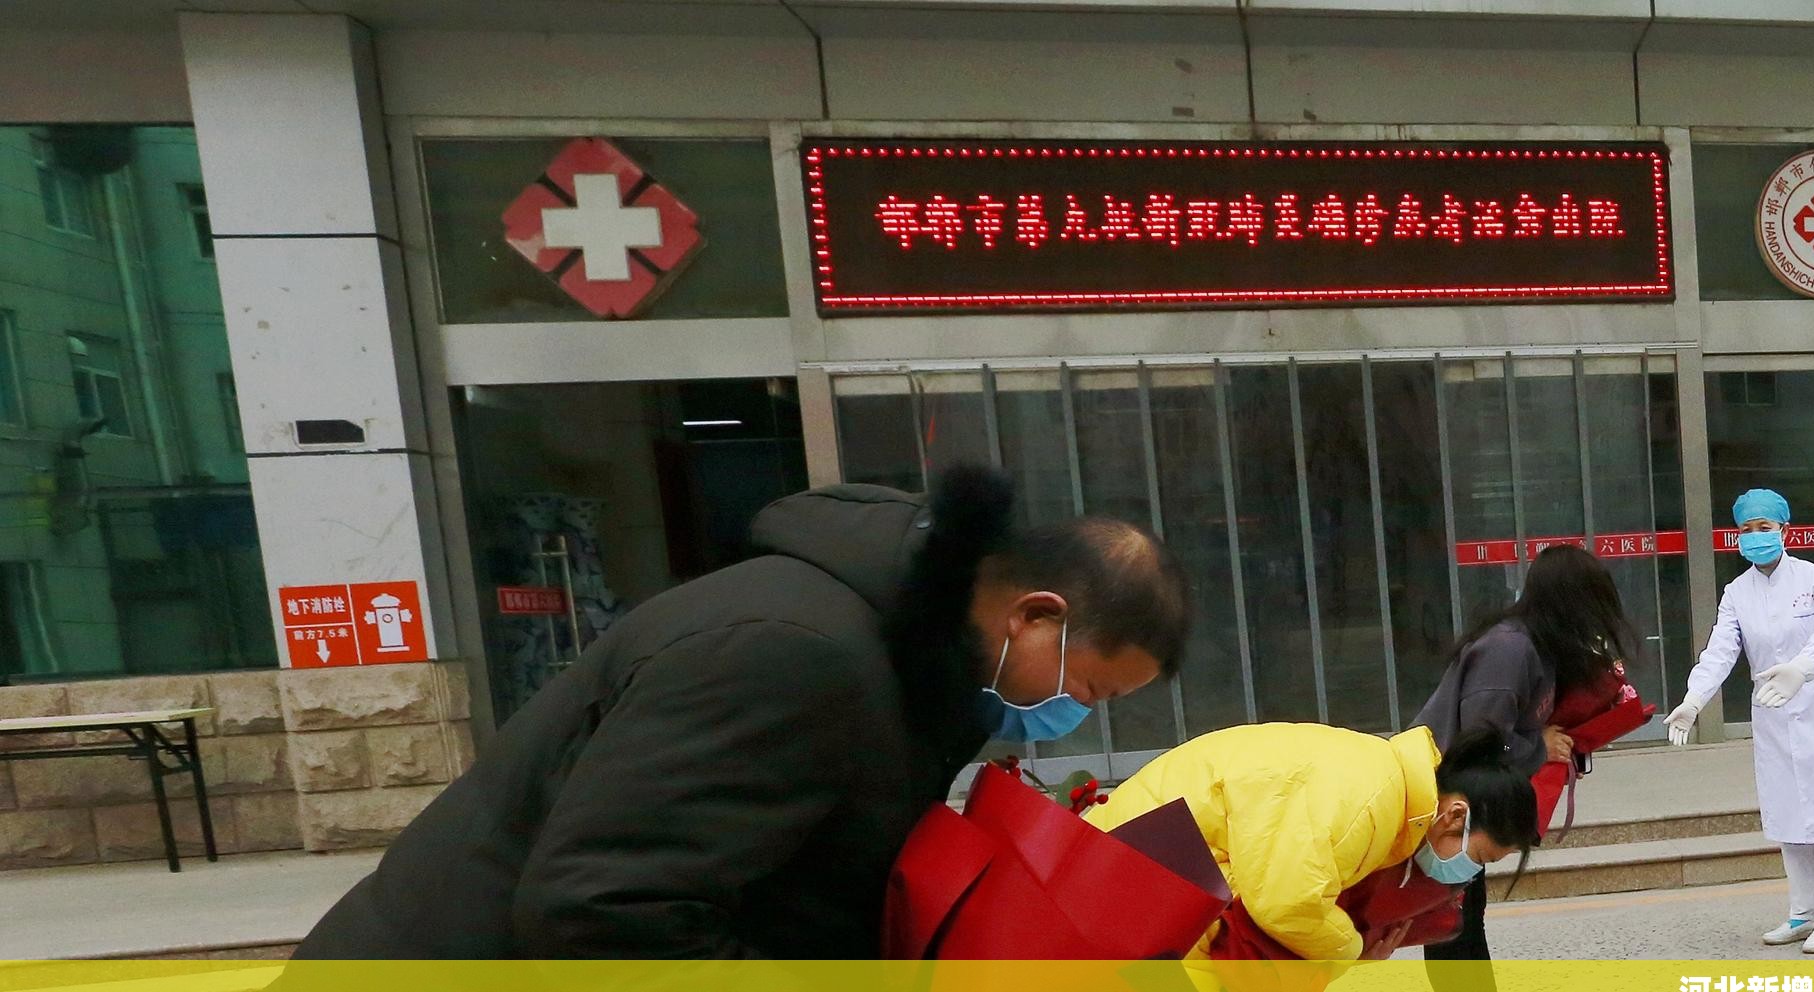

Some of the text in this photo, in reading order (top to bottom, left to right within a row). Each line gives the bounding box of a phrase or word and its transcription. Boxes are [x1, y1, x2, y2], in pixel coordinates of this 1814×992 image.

[287, 596, 345, 616] 地下消防栓
